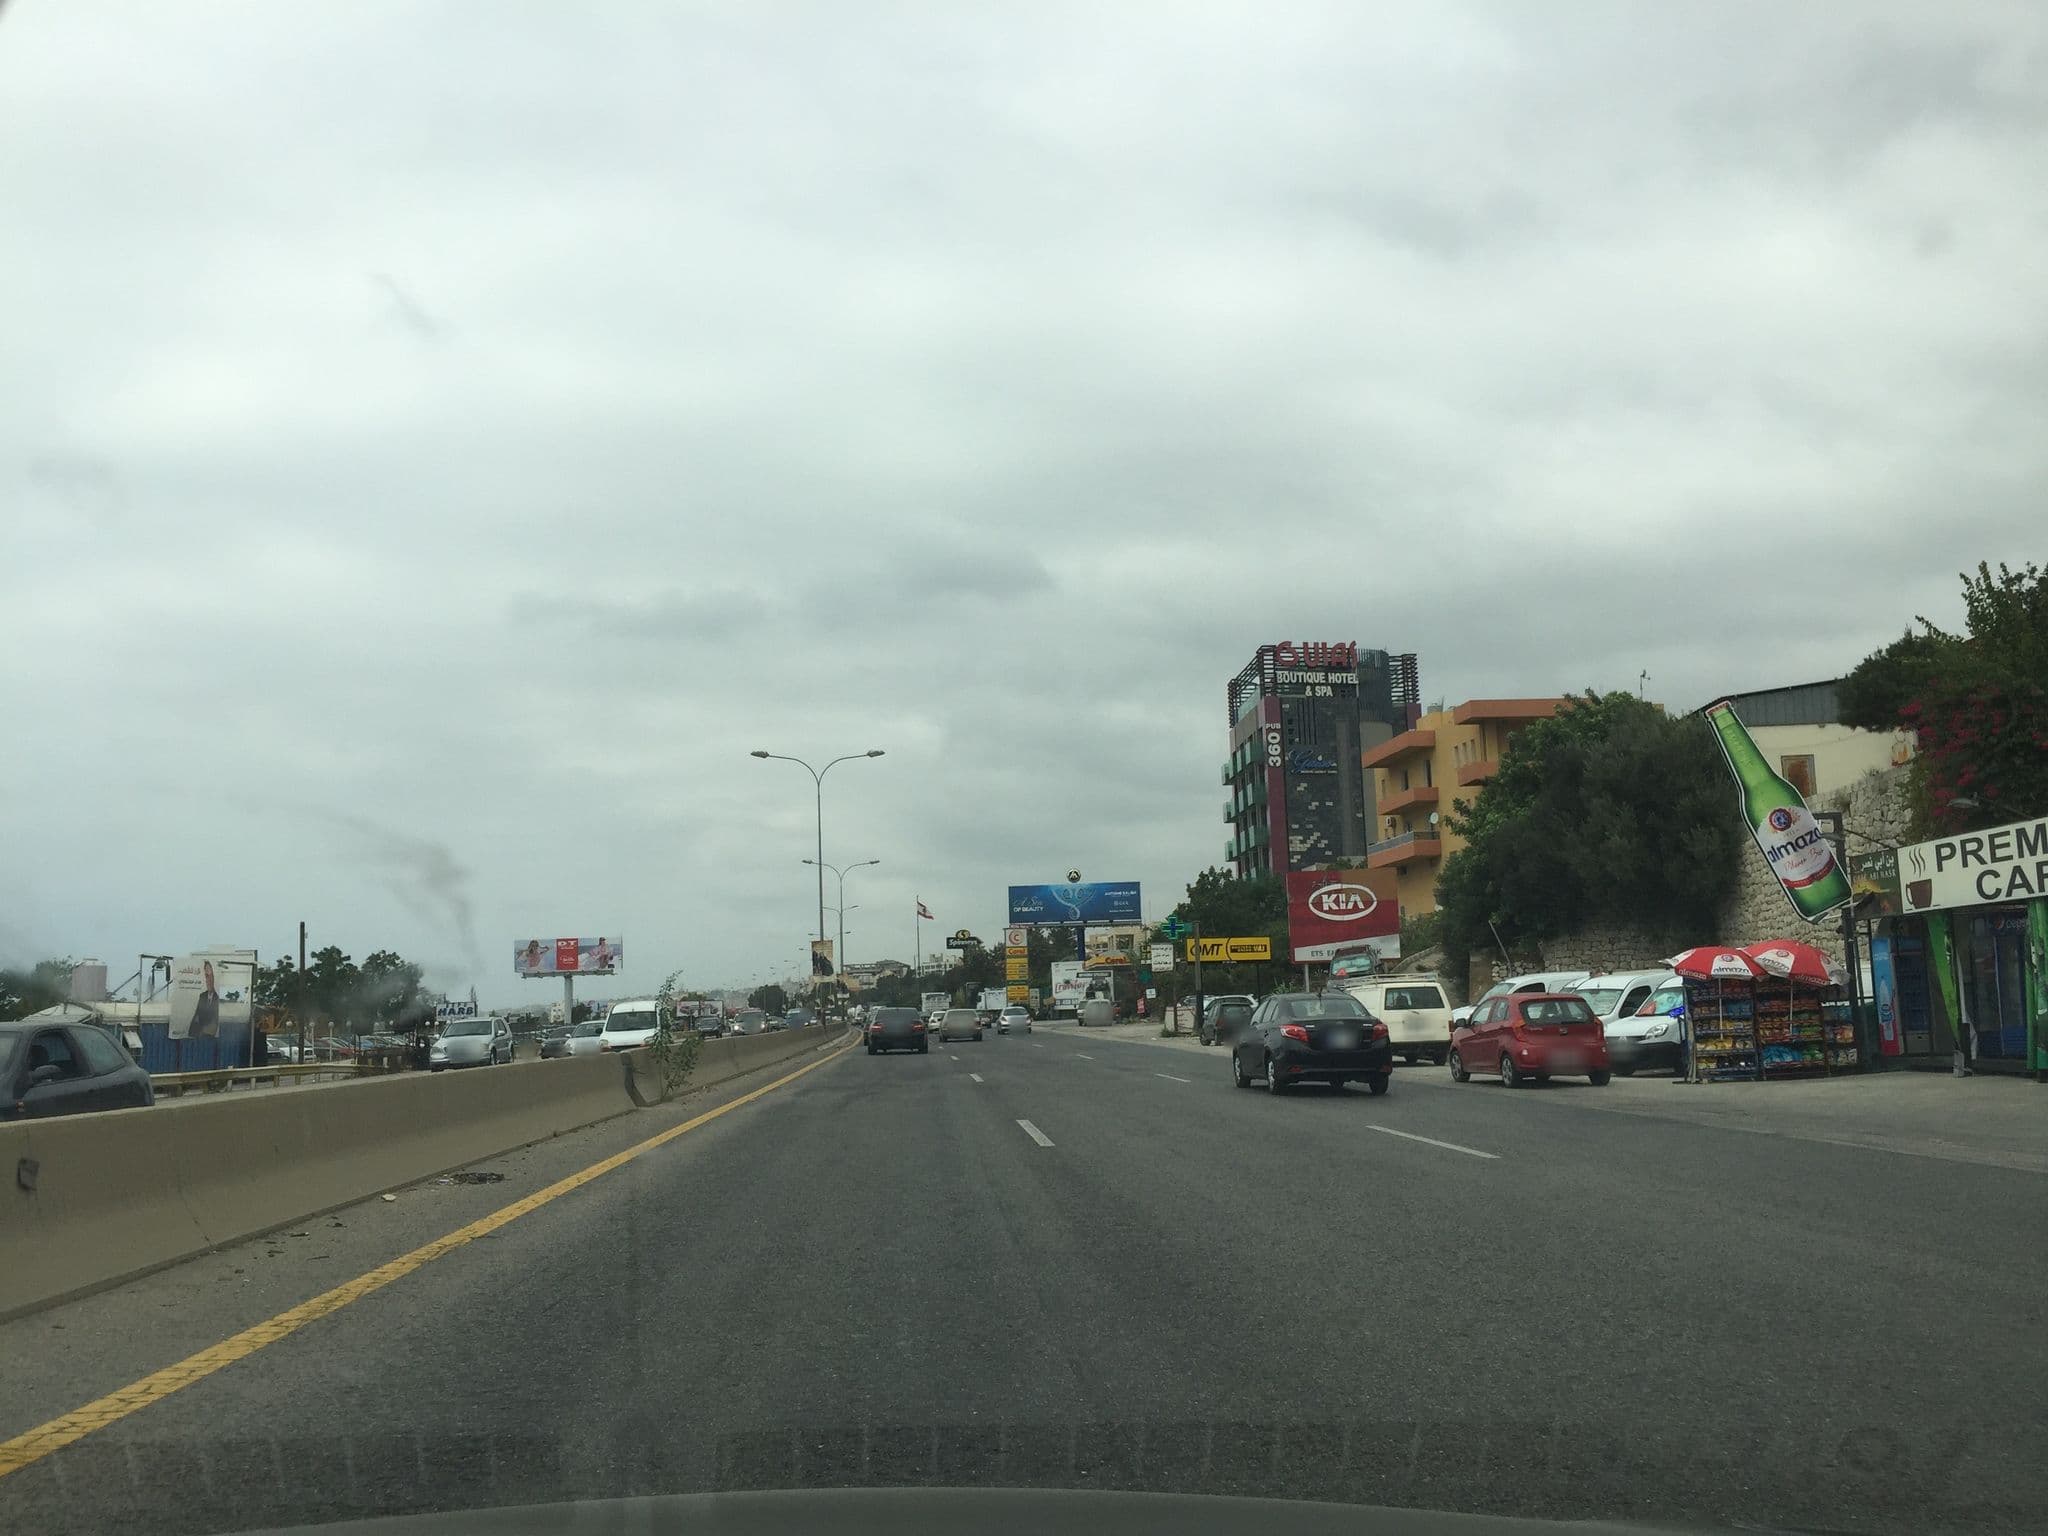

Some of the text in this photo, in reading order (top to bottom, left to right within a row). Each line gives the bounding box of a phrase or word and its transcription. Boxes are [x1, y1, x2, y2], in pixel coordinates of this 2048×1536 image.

[1276, 671, 1359, 684] BOUTIQUE HOTEL
[1305, 685, 1333, 697] & SPA
[1267, 732, 1281, 767] 360
[1935, 823, 2048, 872] PREM
[1321, 893, 1365, 911] KIA
[1678, 969, 1707, 980] almaza
[438, 1006, 474, 1016] HARB
